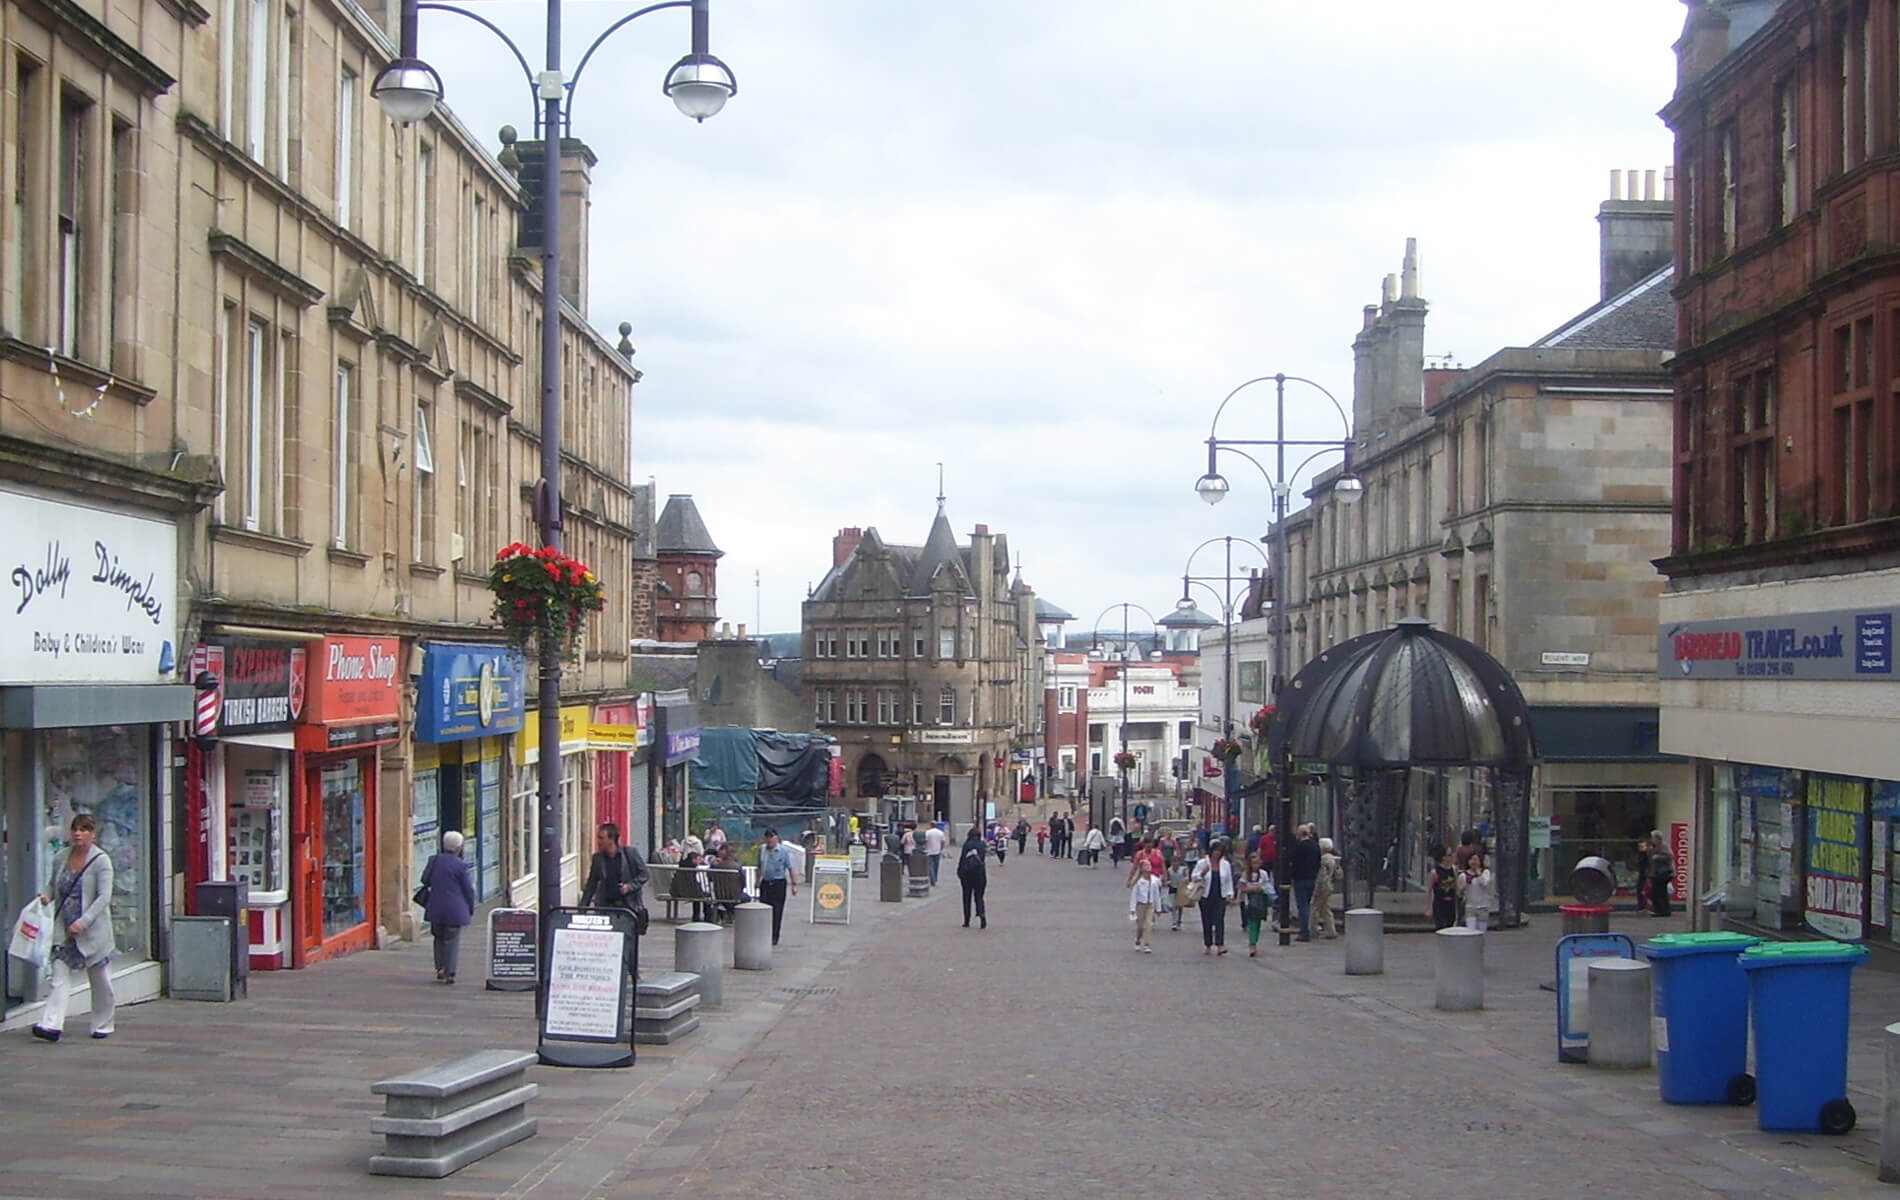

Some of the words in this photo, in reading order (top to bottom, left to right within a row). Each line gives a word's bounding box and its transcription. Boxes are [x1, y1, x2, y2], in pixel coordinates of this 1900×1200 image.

[12, 540, 70, 615] Dolly
[92, 540, 163, 625] Dimples
[33, 631, 61, 660] Baby
[122, 635, 145, 654] Wear
[232, 648, 286, 684] EXPRESS
[325, 643, 364, 682] Phone
[367, 644, 397, 688] Shop
[224, 699, 256, 726] TURKISH
[257, 697, 288, 723] BARBERS
[1807, 876, 1834, 909] SOLD
[1836, 880, 1864, 915] HERE
